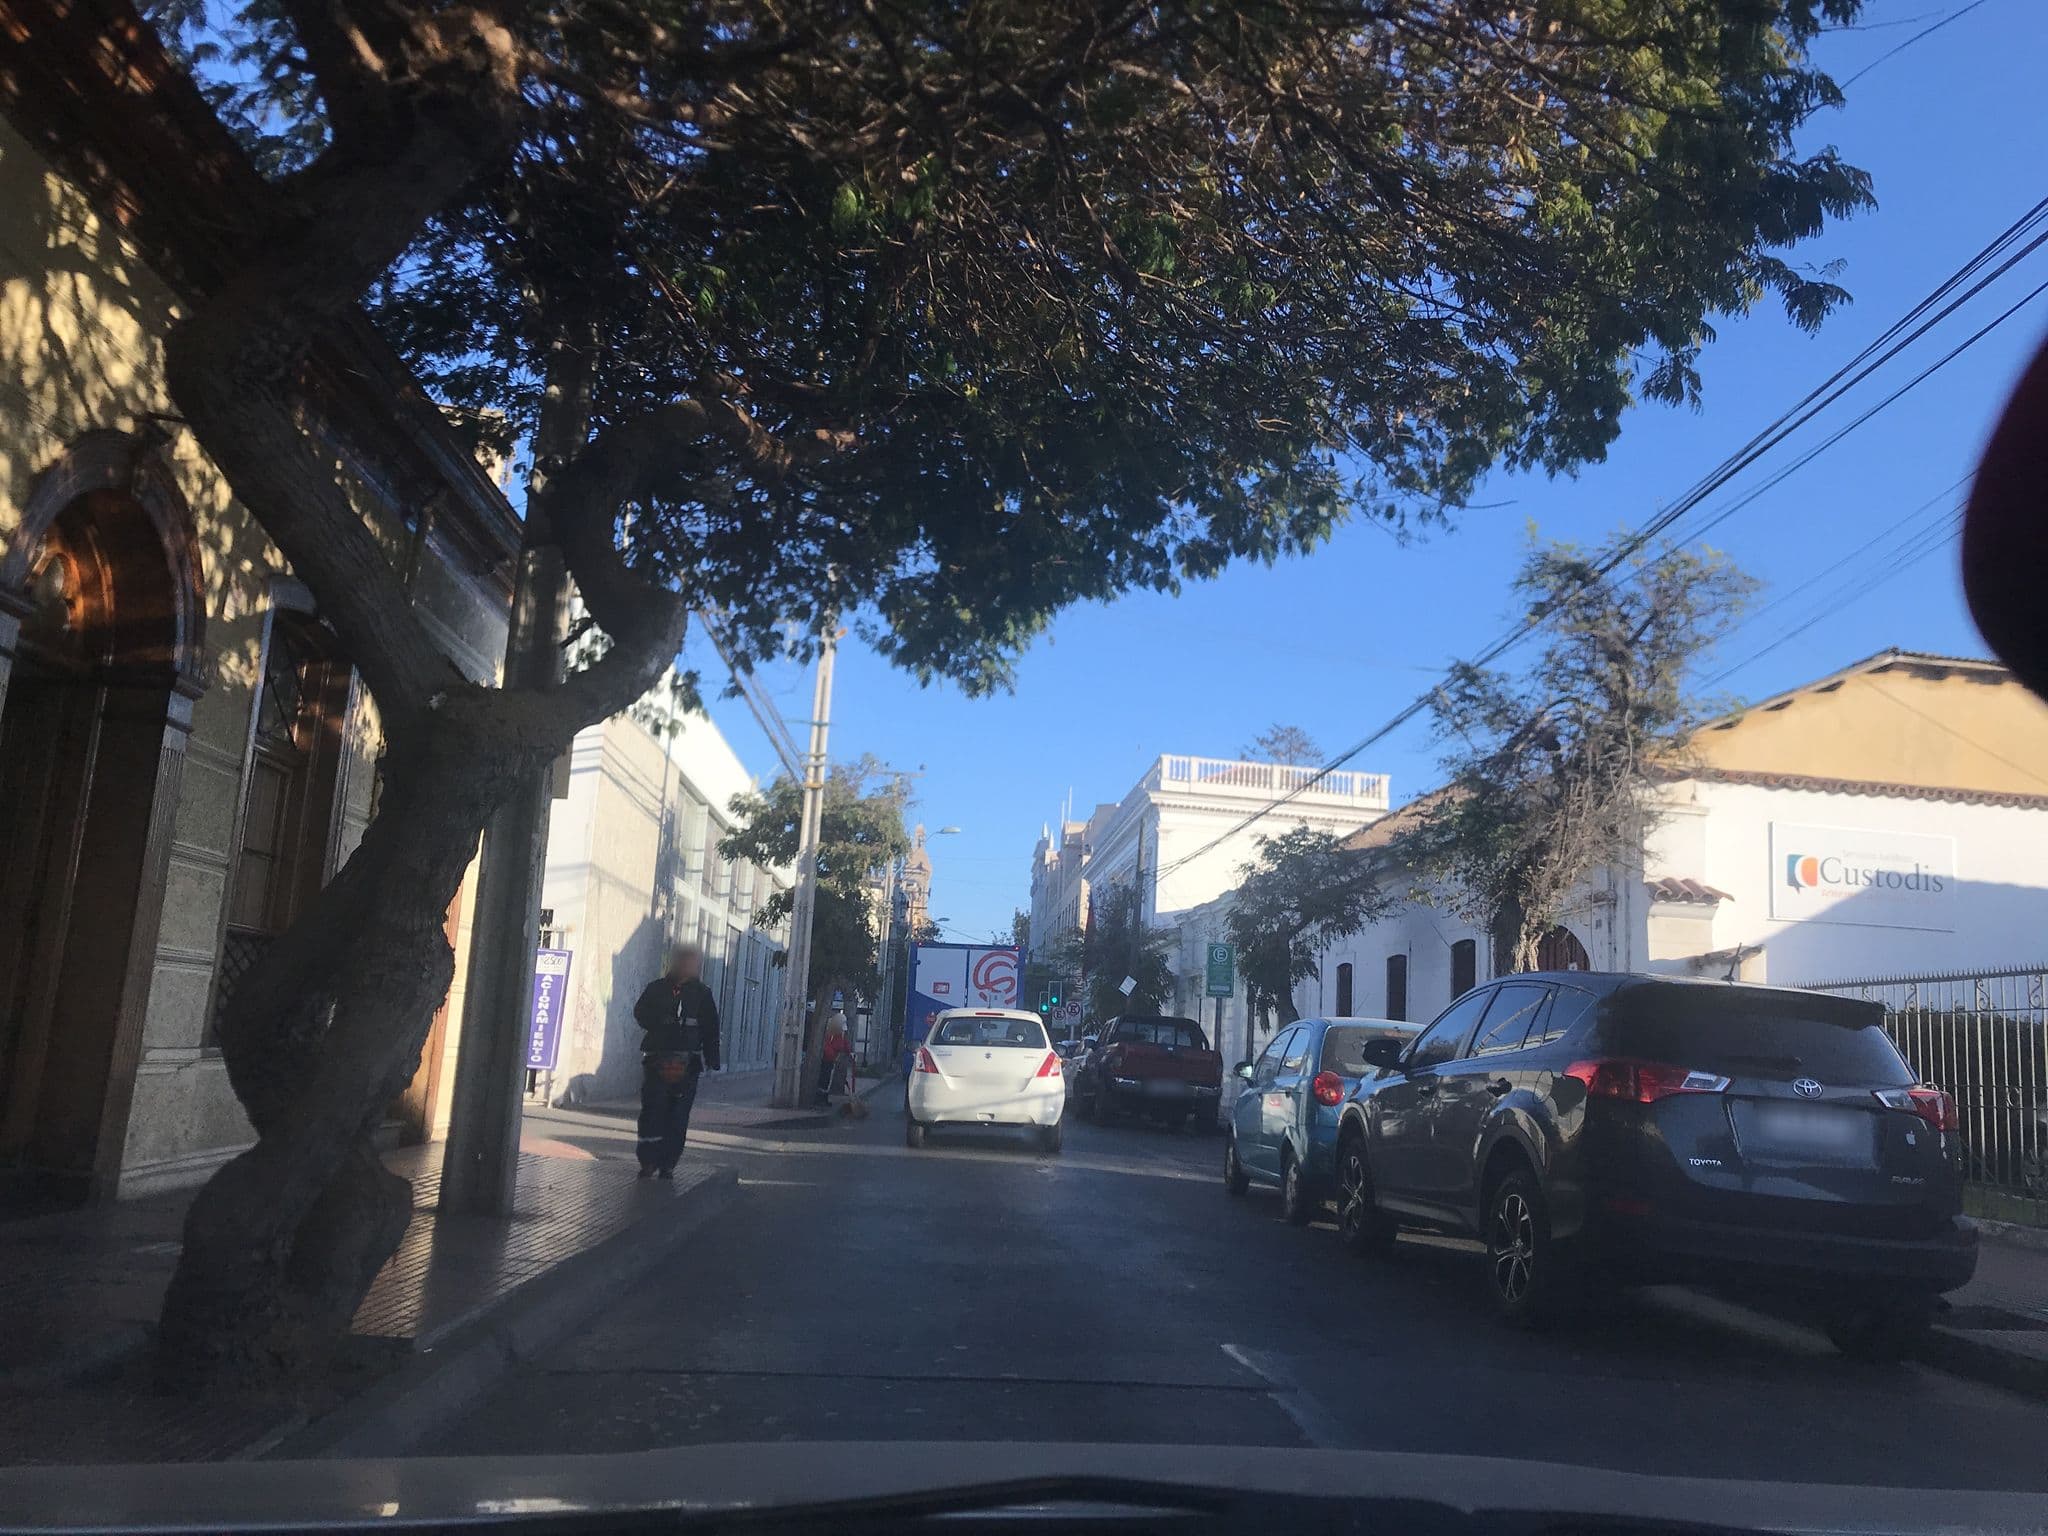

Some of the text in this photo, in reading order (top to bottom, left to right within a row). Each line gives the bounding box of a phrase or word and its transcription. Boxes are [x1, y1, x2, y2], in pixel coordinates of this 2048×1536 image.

[1820, 856, 1944, 893] Custodis
[530, 975, 553, 1061] ACIONAMIENTO
[1689, 1158, 1722, 1167] TOYOTA
